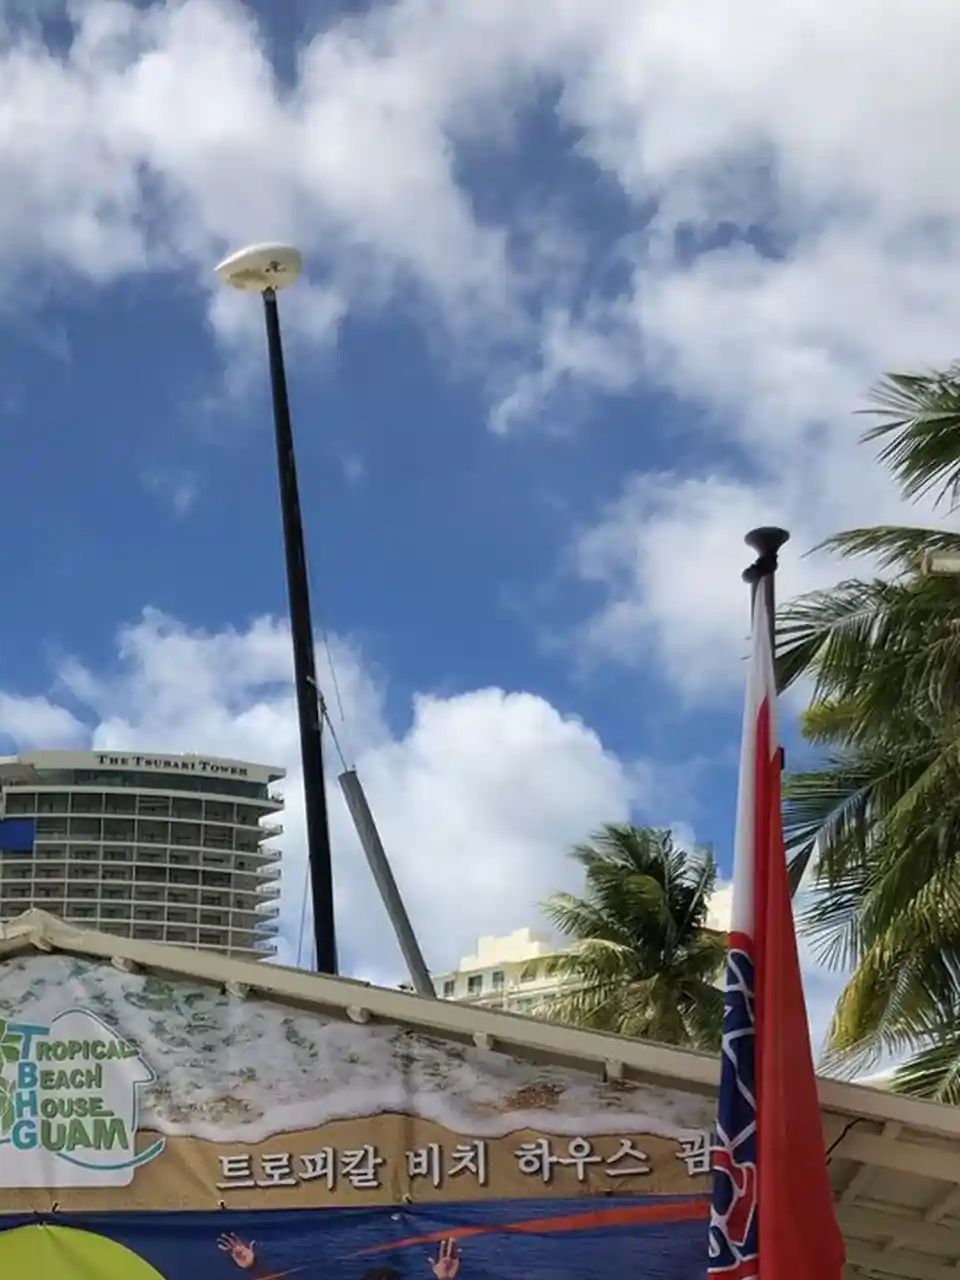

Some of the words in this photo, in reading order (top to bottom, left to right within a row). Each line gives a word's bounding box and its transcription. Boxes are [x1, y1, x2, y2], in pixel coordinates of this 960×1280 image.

[97, 754, 129, 767] THE
[132, 756, 196, 771] TSUBAKI
[199, 761, 249, 777] TOWER
[6, 1022, 140, 1062] TROPICAL
[17, 1061, 103, 1091] BEACH
[14, 1090, 116, 1118] HOUSE
[11, 1118, 129, 1152] GUAM
[215, 1143, 386, 1191] 트로피칼
[406, 1138, 492, 1187] 비치
[514, 1137, 650, 1183] 하우스
